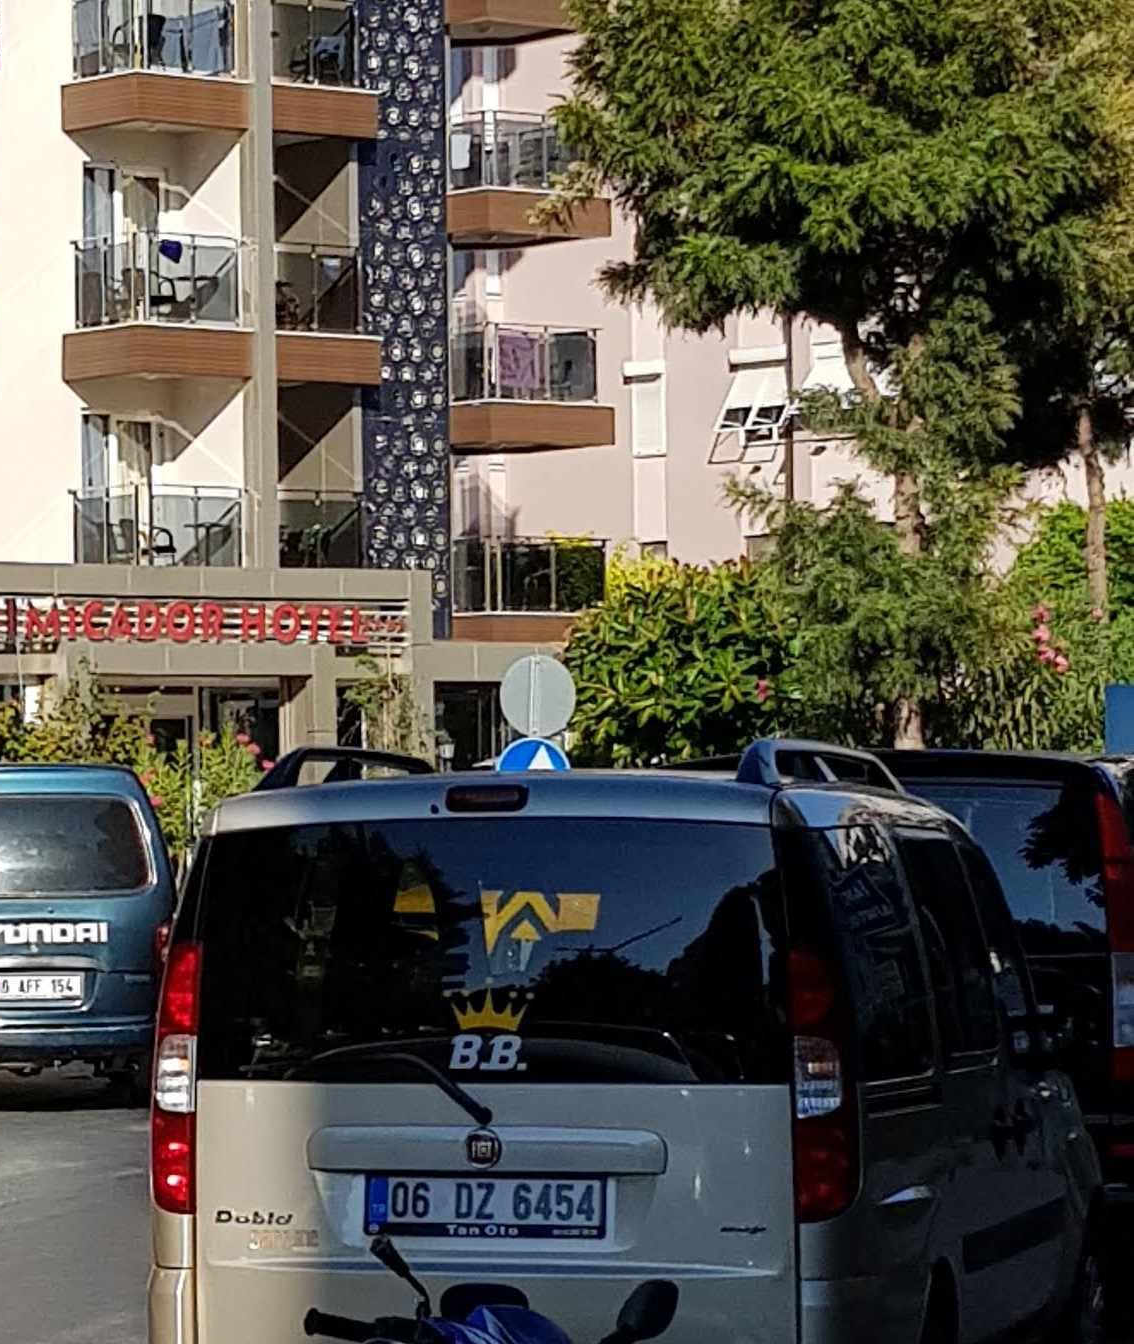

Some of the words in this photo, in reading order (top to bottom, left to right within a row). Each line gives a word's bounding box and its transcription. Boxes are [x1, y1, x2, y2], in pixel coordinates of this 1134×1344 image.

[241, 603, 370, 644] HOTEL
[391, 1181, 431, 1218] 06
[454, 1182, 496, 1220] DZ
[513, 1183, 595, 1222] 6454
[446, 1223, 480, 1235] Tan
[484, 1224, 519, 1236] Oto
